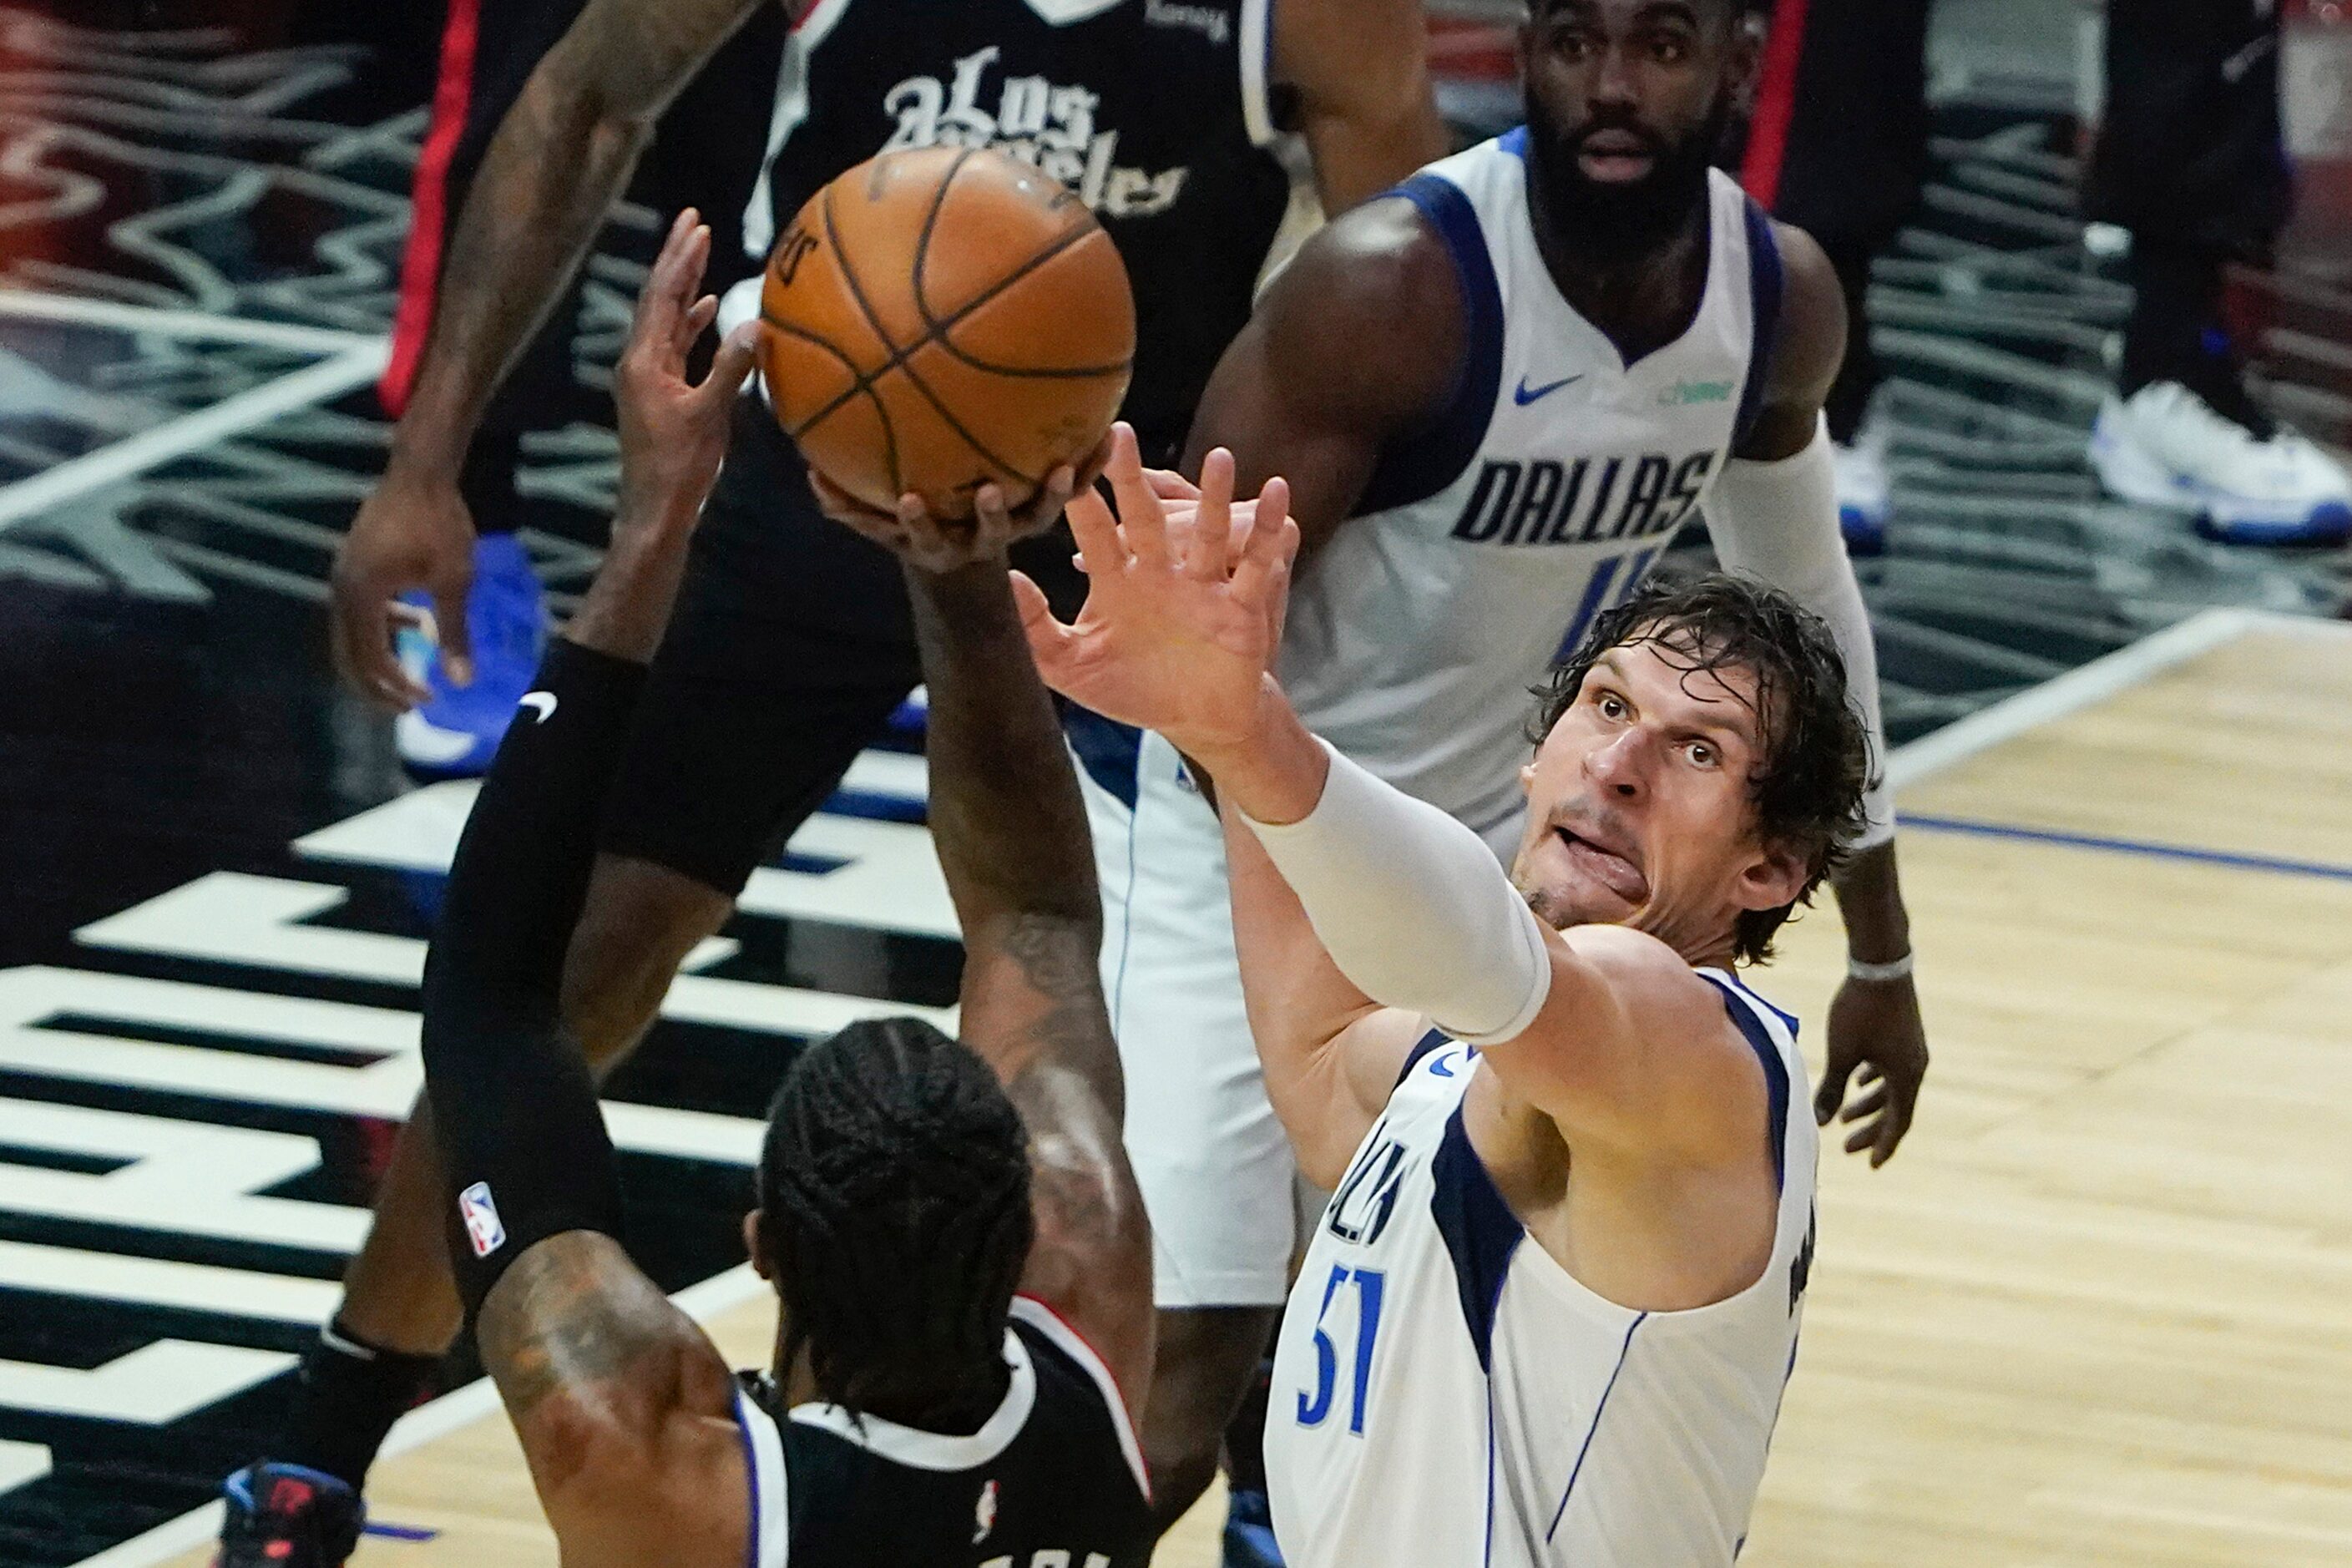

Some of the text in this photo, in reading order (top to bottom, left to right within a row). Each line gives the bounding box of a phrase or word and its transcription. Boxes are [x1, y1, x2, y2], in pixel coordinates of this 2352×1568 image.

[938, 45, 1100, 150] Los
[1449, 447, 1718, 547] DALLAS
[1296, 1262, 1387, 1439] 51
